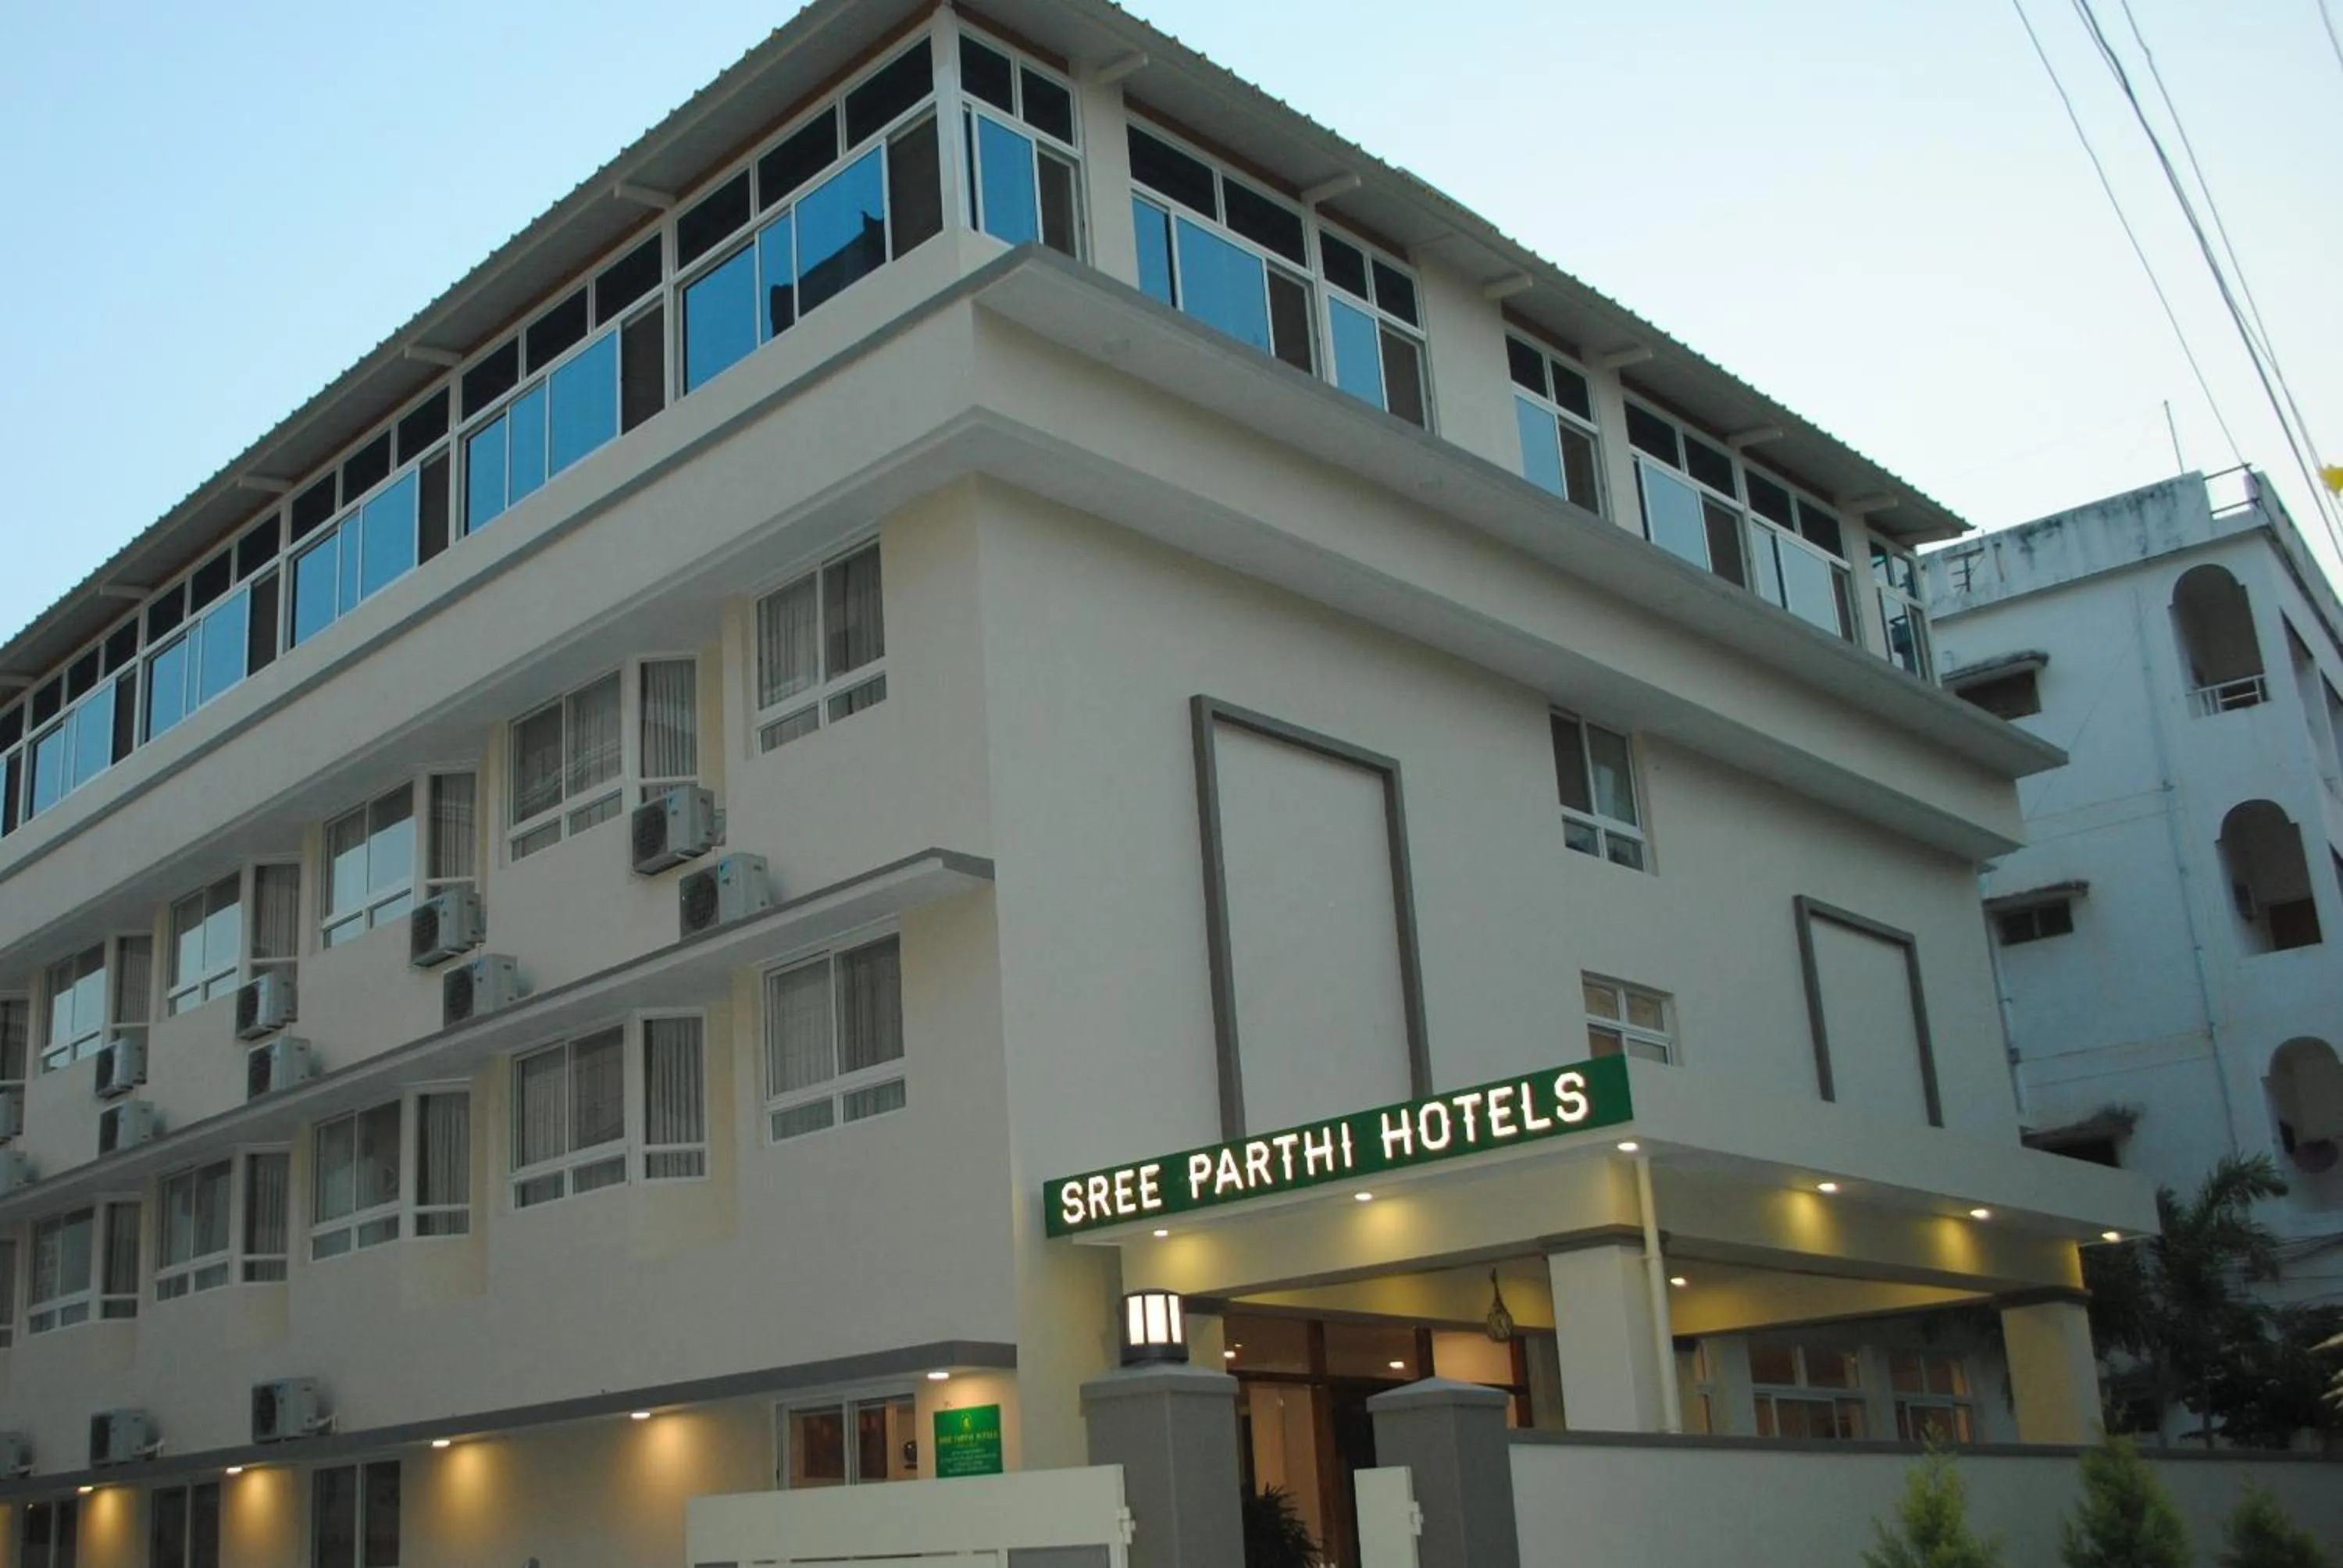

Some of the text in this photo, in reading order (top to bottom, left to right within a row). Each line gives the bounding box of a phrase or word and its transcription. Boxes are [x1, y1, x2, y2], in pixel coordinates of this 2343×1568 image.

[1061, 1071, 1589, 1224] SREE PARTHI HOTELS
